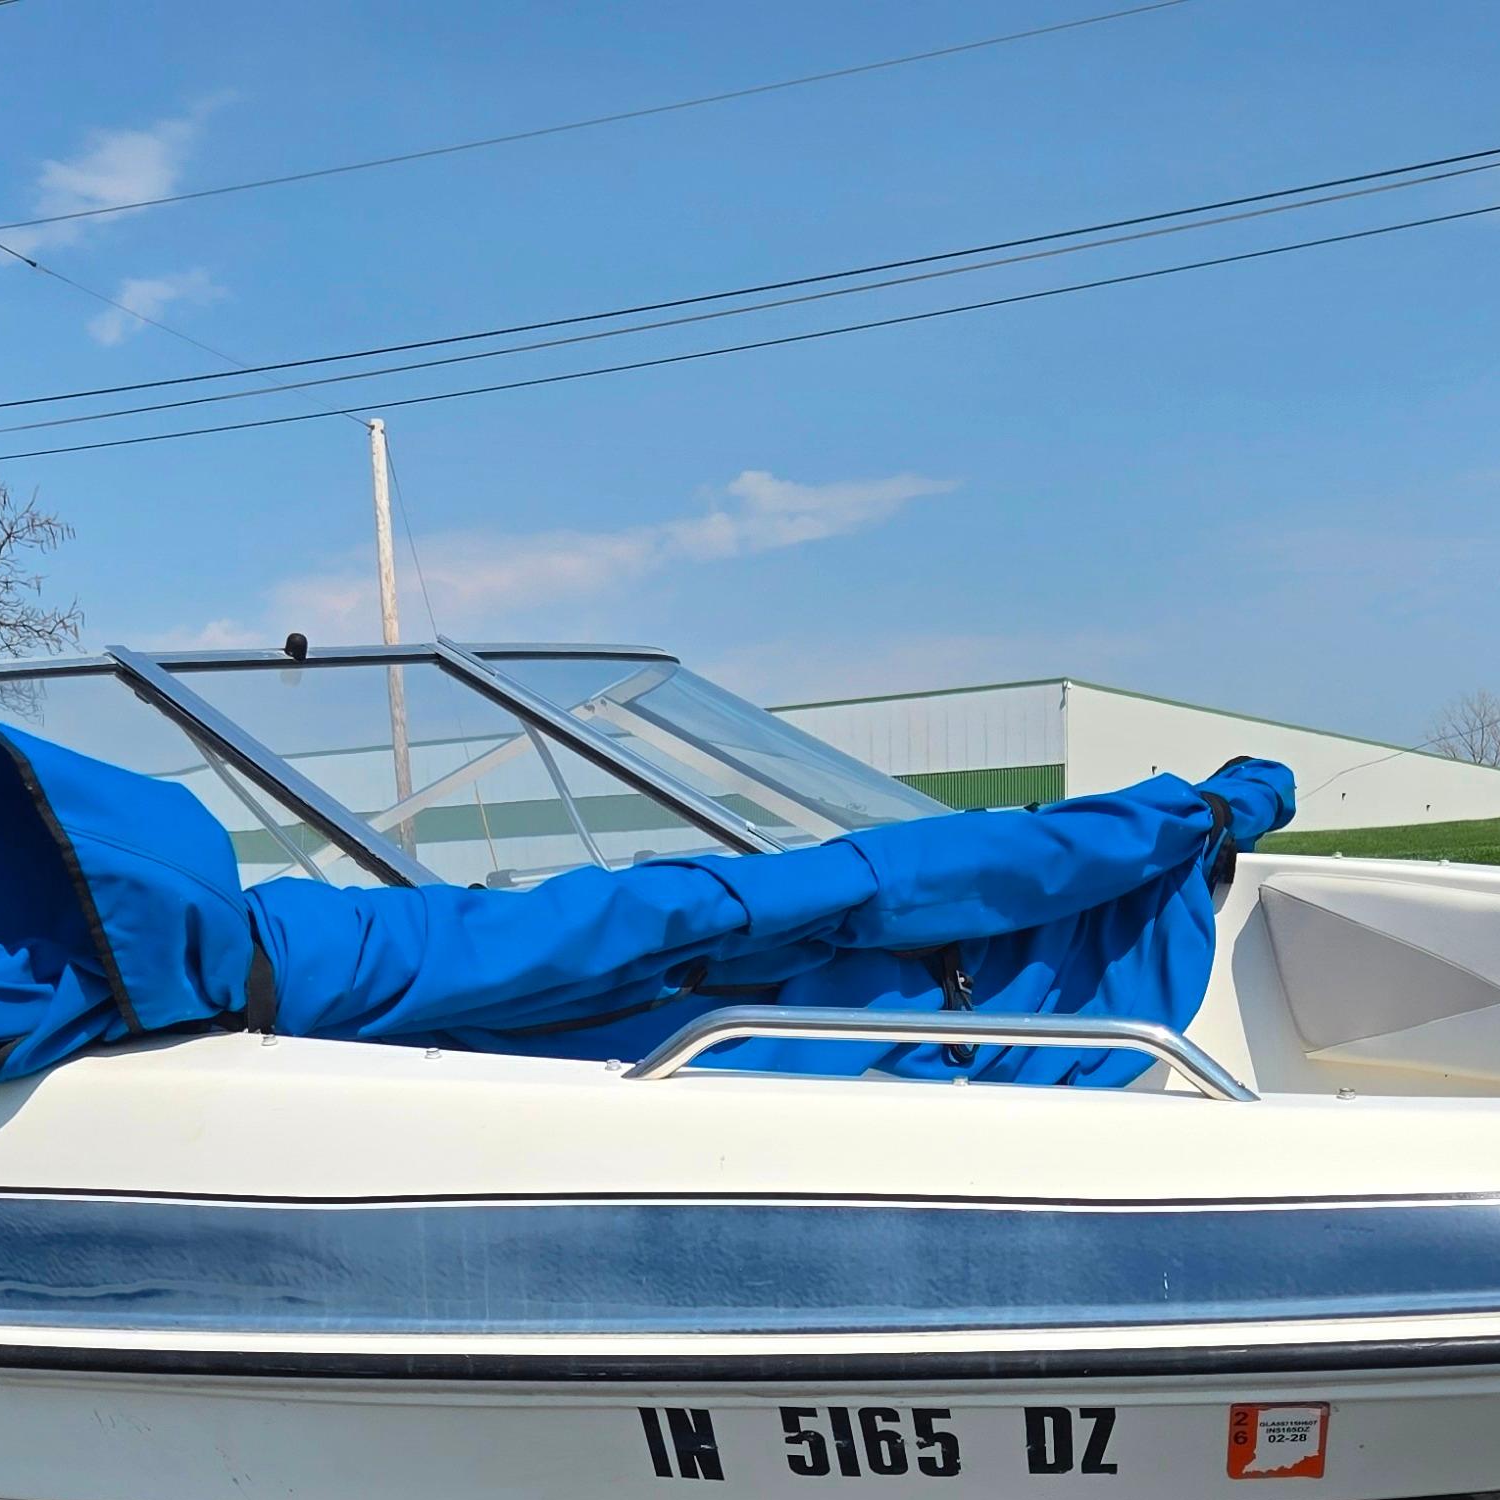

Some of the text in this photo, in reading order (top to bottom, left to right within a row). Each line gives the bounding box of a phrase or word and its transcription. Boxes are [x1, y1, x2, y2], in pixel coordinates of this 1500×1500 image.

[637, 1406, 1118, 1481] IN 5165 DZ
[1268, 1433, 1307, 1443] 02-28
